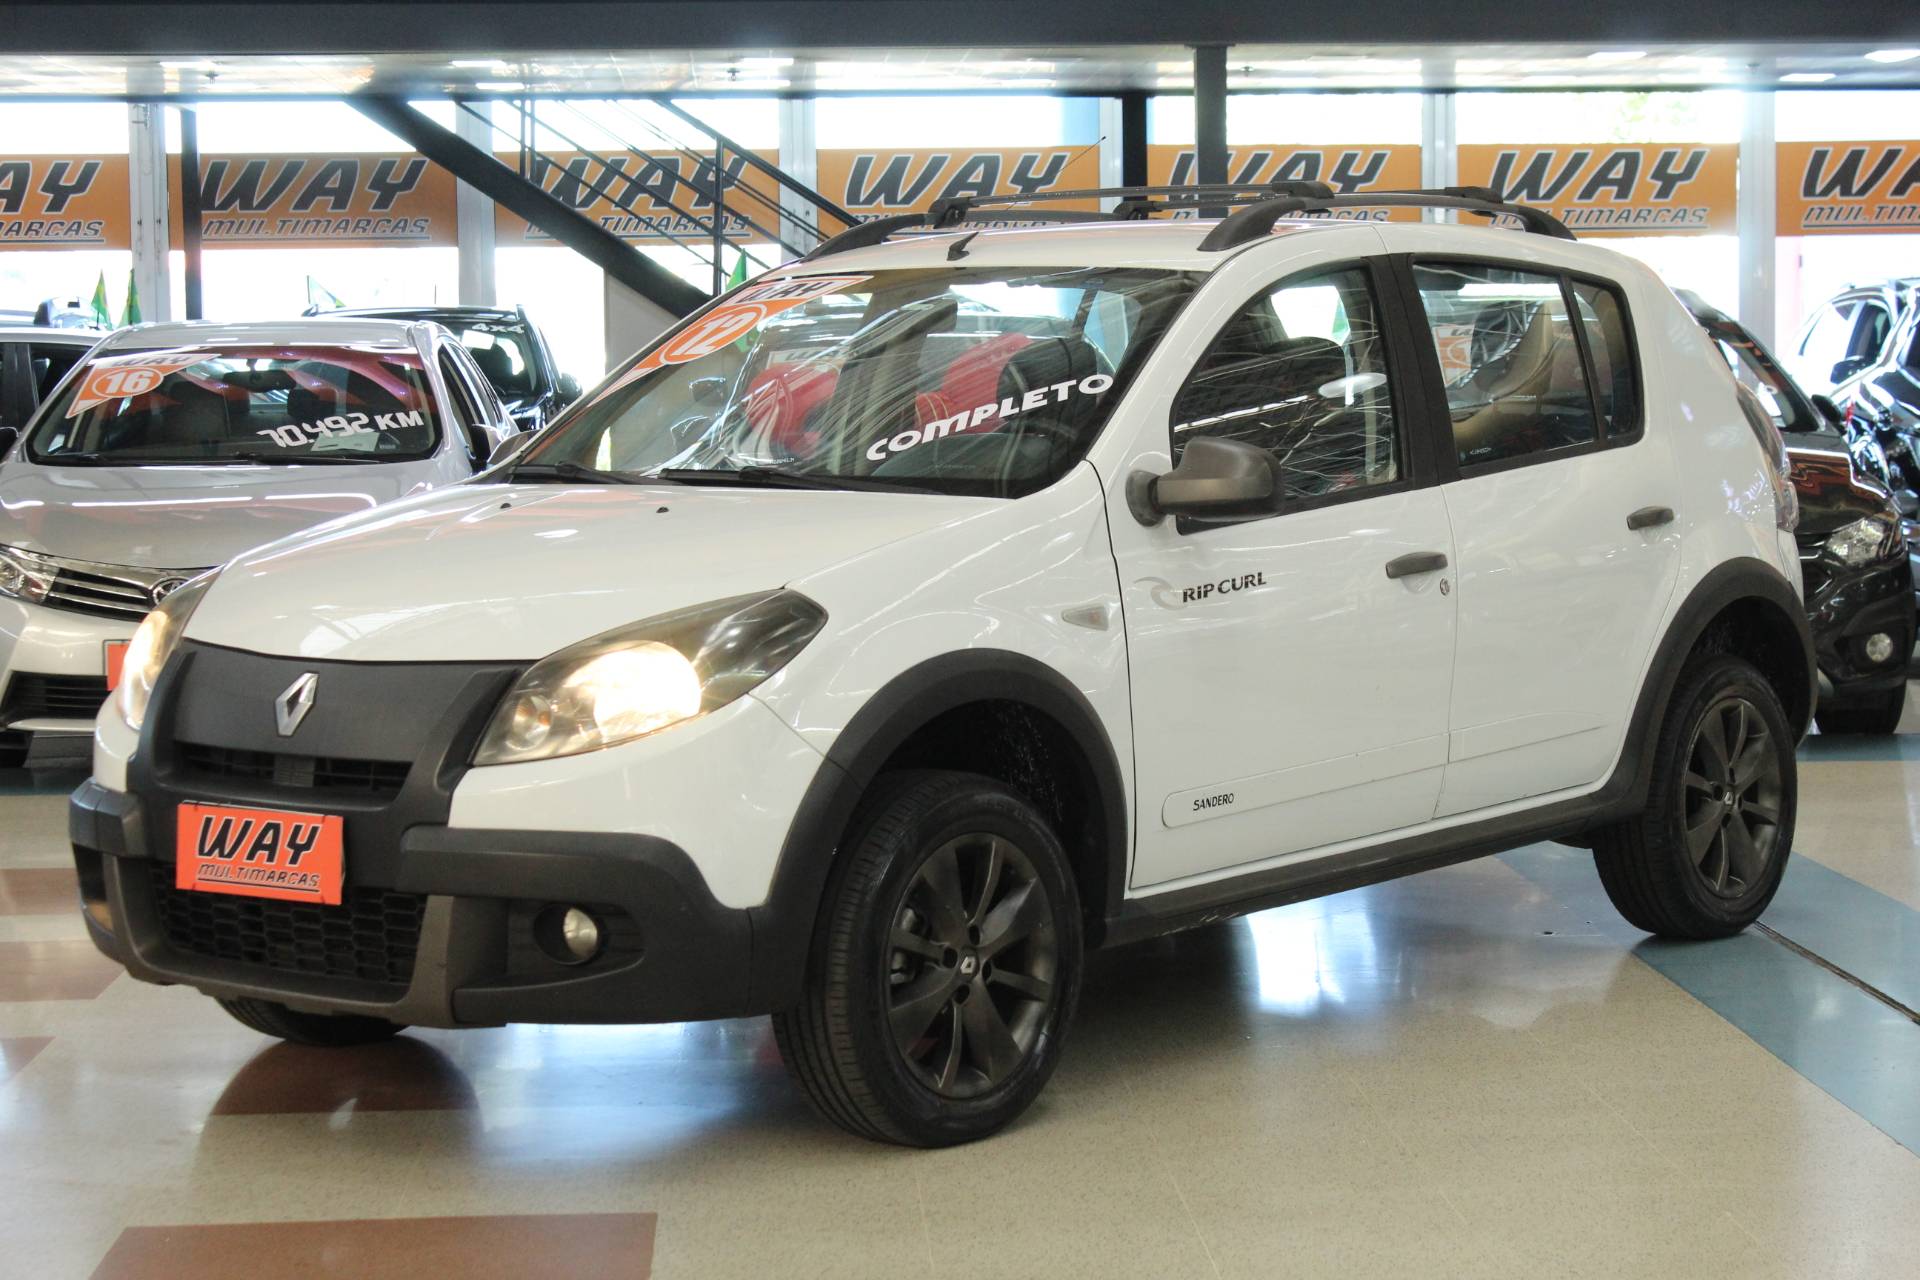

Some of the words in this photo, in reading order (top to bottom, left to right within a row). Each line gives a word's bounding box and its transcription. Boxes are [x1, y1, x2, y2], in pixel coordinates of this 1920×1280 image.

[200, 158, 429, 213] WAY
[845, 152, 1071, 208] WAY
[1491, 148, 1709, 202] WAY
[0, 220, 105, 237] ARCAS
[201, 217, 431, 235] MULTIMARCAS
[672, 310, 757, 357] 12
[105, 369, 155, 395] 16
[256, 412, 375, 448] 70.492
[373, 410, 425, 431] KM
[866, 373, 1114, 461] COMPLETO
[1217, 572, 1267, 594] CURL
[1192, 793, 1235, 811] SANDERO
[195, 814, 323, 868] WAY
[197, 863, 321, 888] MULTIMARCAS
